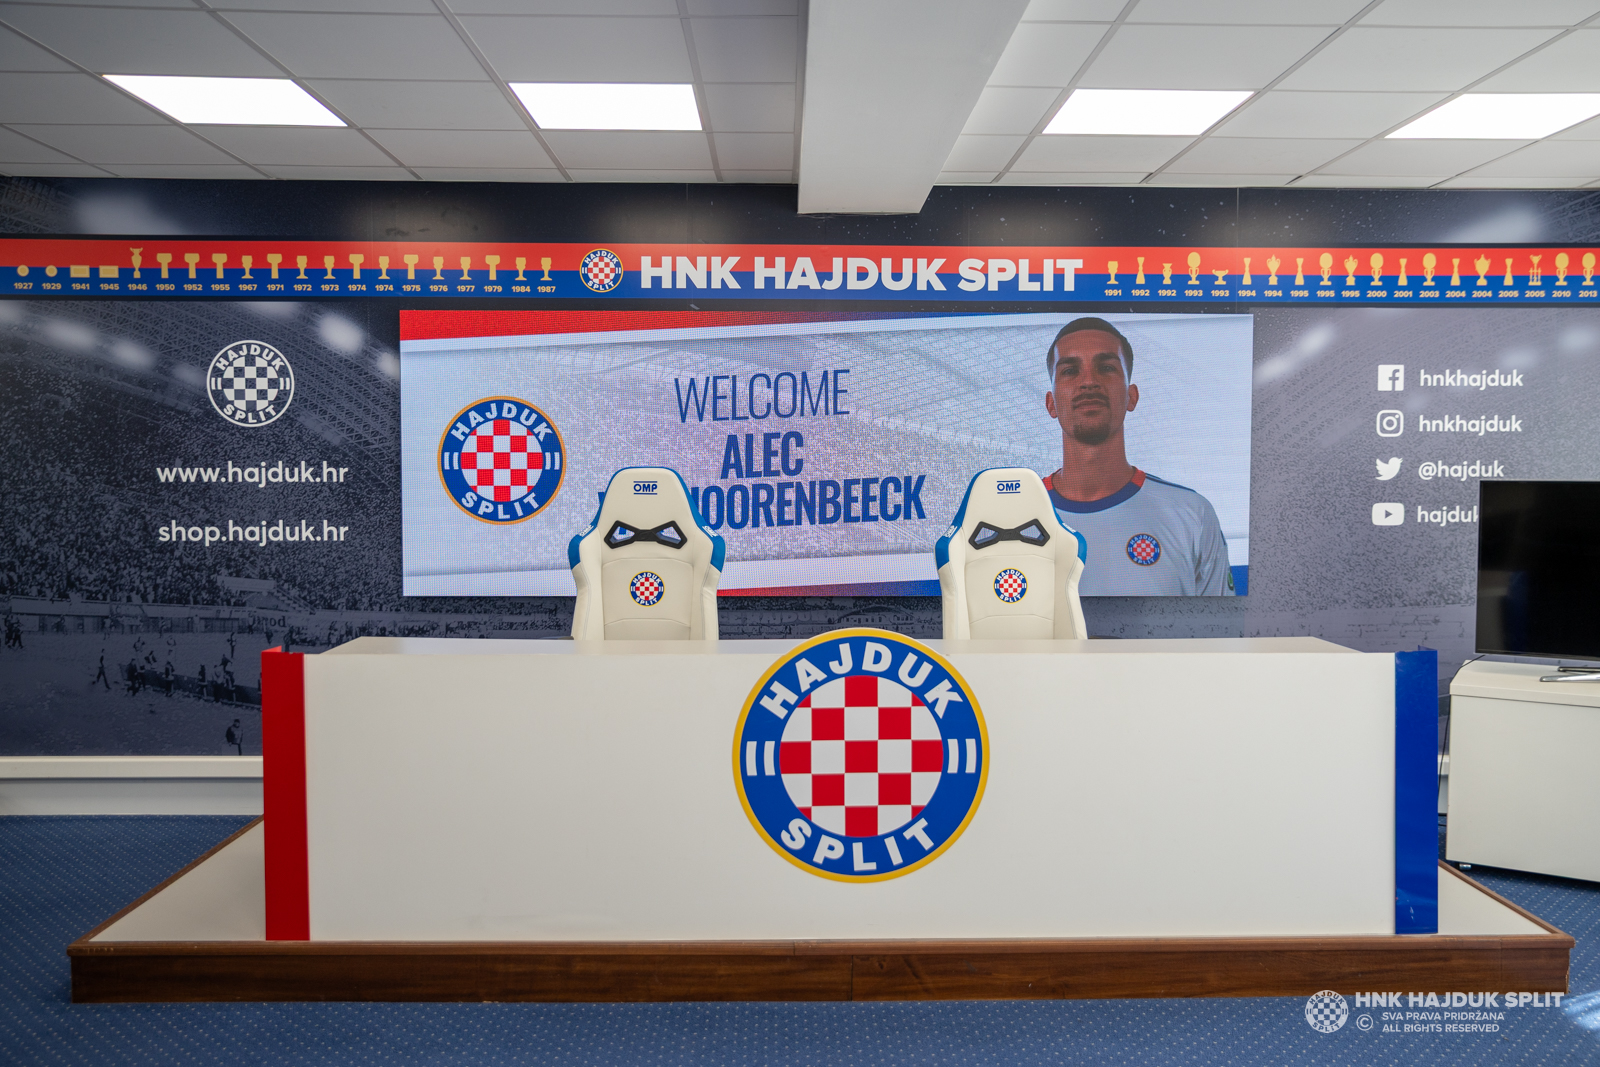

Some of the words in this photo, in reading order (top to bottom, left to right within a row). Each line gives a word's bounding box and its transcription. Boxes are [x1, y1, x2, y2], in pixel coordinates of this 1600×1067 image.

[584, 250, 619, 264] HAJDUK
[640, 255, 741, 289] HNK
[754, 256, 947, 290] HAJDUK
[957, 258, 1084, 292] SPLIT
[13, 282, 33, 290] 1927
[41, 282, 62, 290] 1929
[99, 283, 120, 291] 1945
[127, 283, 148, 291] 1946
[155, 283, 176, 291] 1950
[183, 283, 203, 291] 1952
[210, 283, 231, 291] 1955
[238, 283, 258, 291] 1967
[266, 283, 285, 291] 1971
[293, 284, 312, 292] 1972
[320, 284, 340, 292] 1973
[347, 284, 367, 292] 1974
[375, 284, 394, 292] 1974
[402, 284, 421, 292] 1975
[429, 284, 449, 292] 1976
[483, 285, 503, 293] 1979
[511, 285, 531, 293] 1984
[537, 285, 556, 293] 1987
[587, 280, 615, 291] SPLIT
[1131, 289, 1150, 297] 1992
[1157, 289, 1177, 297] 1992
[1184, 289, 1203, 297] 1993
[1211, 289, 1230, 297] 1993
[1237, 289, 1257, 297] 1994
[1316, 290, 1335, 298] 1995
[1341, 290, 1360, 298] 1995
[1366, 290, 1387, 298] 2000
[1394, 290, 1413, 298] 2001
[1419, 290, 1440, 298] 2003
[1445, 290, 1466, 298] 2004
[1472, 290, 1493, 298] 2004
[1498, 290, 1519, 298] 2005
[1525, 290, 1546, 298] 2005
[1552, 290, 1572, 298] 2010
[1579, 290, 1598, 298] 2013
[215, 344, 285, 371] HAJDUK
[1419, 369, 1524, 391] hnkhajduk
[674, 369, 850, 423] WELCOME
[223, 403, 277, 423] SPLIT
[450, 402, 553, 442] HAJDUK
[1418, 414, 1523, 436] hnkhajduk
[720, 431, 804, 480] ALEC
[156, 460, 349, 488] www.hajduk.hr
[1418, 460, 1505, 482] @hajduk
[633, 483, 658, 493] OMP
[996, 482, 1021, 492] OMP
[461, 491, 540, 520] SPLIT
[158, 519, 349, 547] shop.hajduk.hr
[632, 572, 662, 585] HAJDUK
[996, 569, 1025, 581] HAJDUK
[759, 641, 964, 720] HAJDUK
[780, 817, 935, 872] SPLIT
